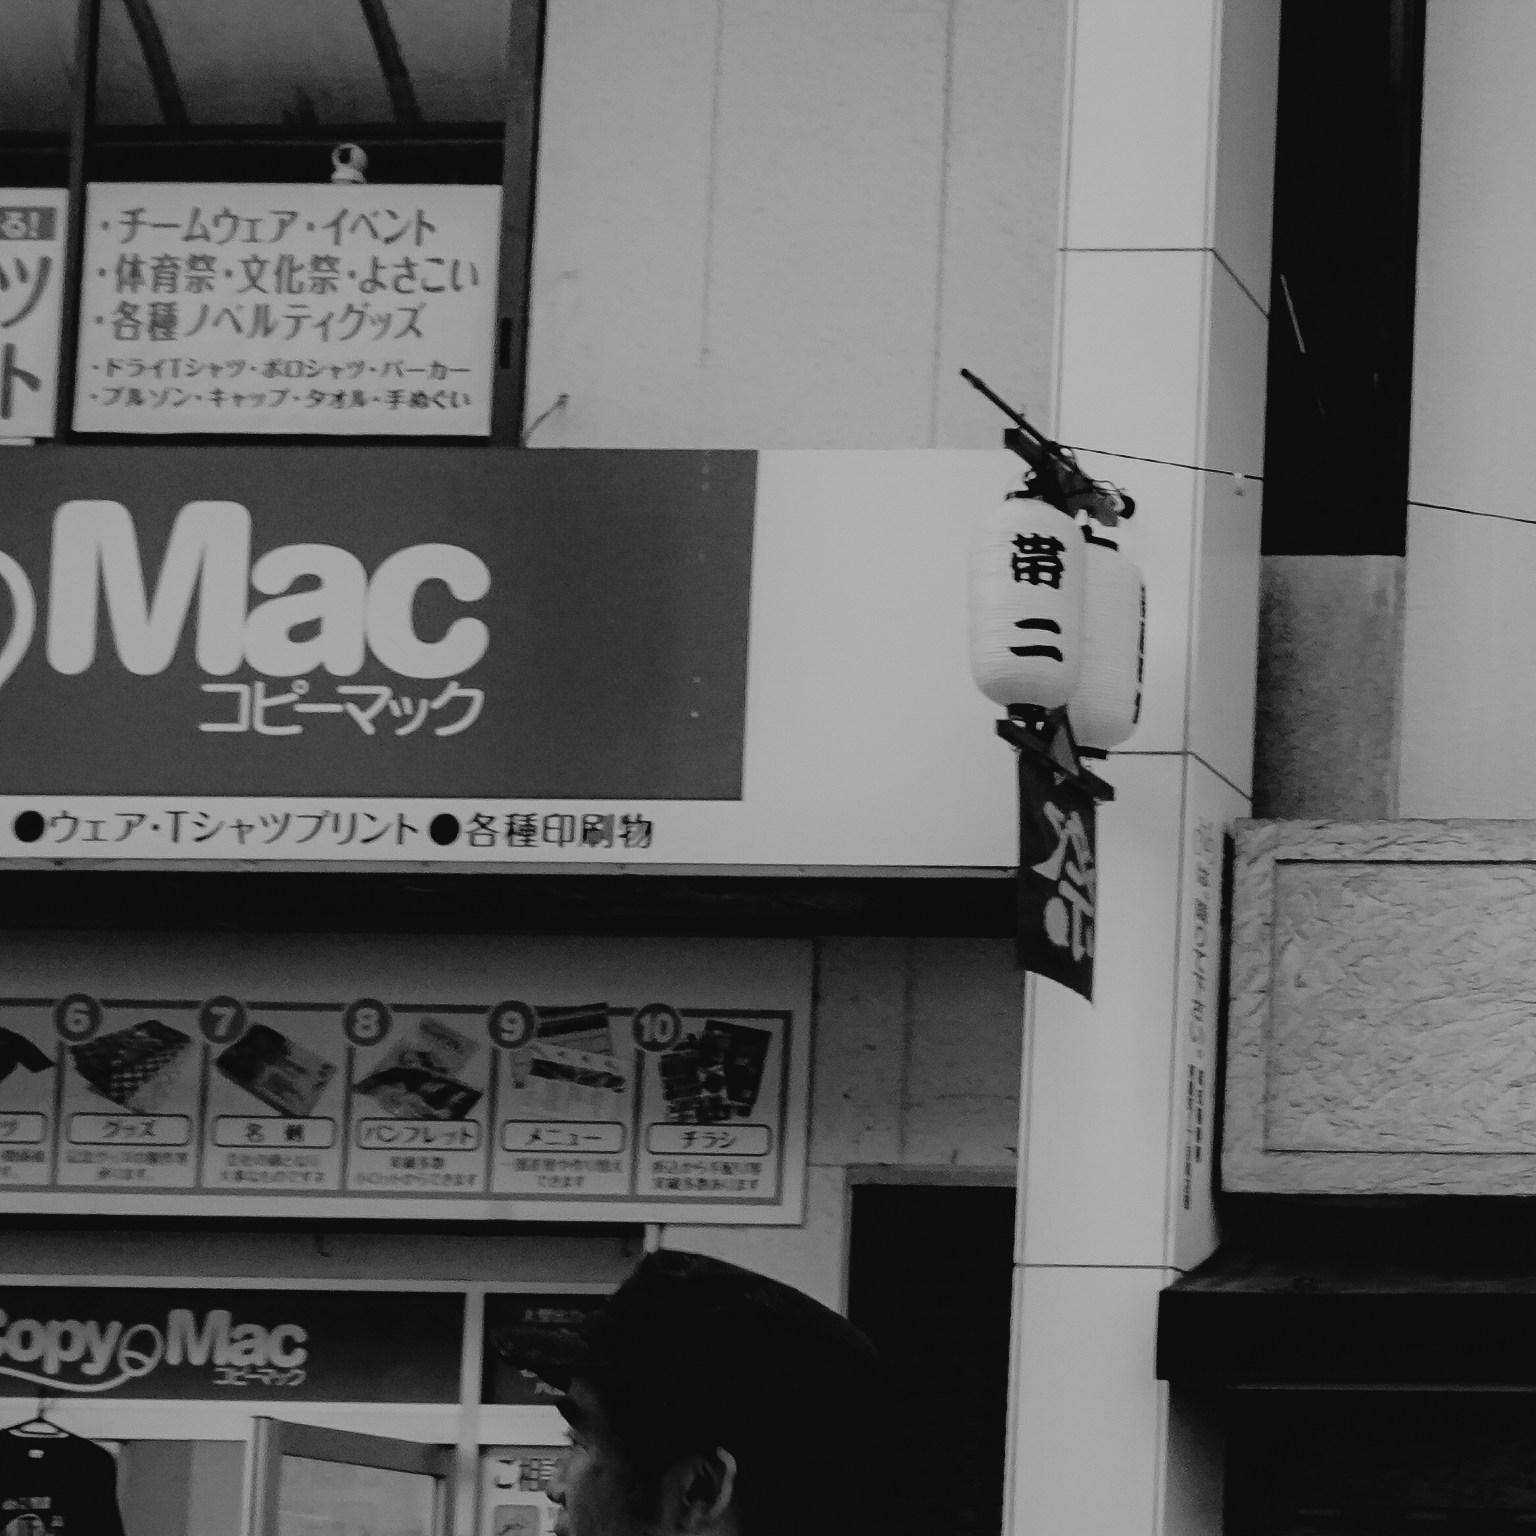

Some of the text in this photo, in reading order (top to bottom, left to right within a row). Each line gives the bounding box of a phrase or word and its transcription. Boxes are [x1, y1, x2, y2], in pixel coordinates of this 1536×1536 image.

[46, 498, 492, 679] Mac
[198, 680, 485, 738] コピーマック
[465, 811, 654, 851] 各種印刷物
[211, 1006, 236, 1033] 7
[356, 1008, 381, 1036] 8
[499, 1011, 524, 1038] 9
[639, 1013, 674, 1041] 10
[164, 1307, 310, 1370] Mac
